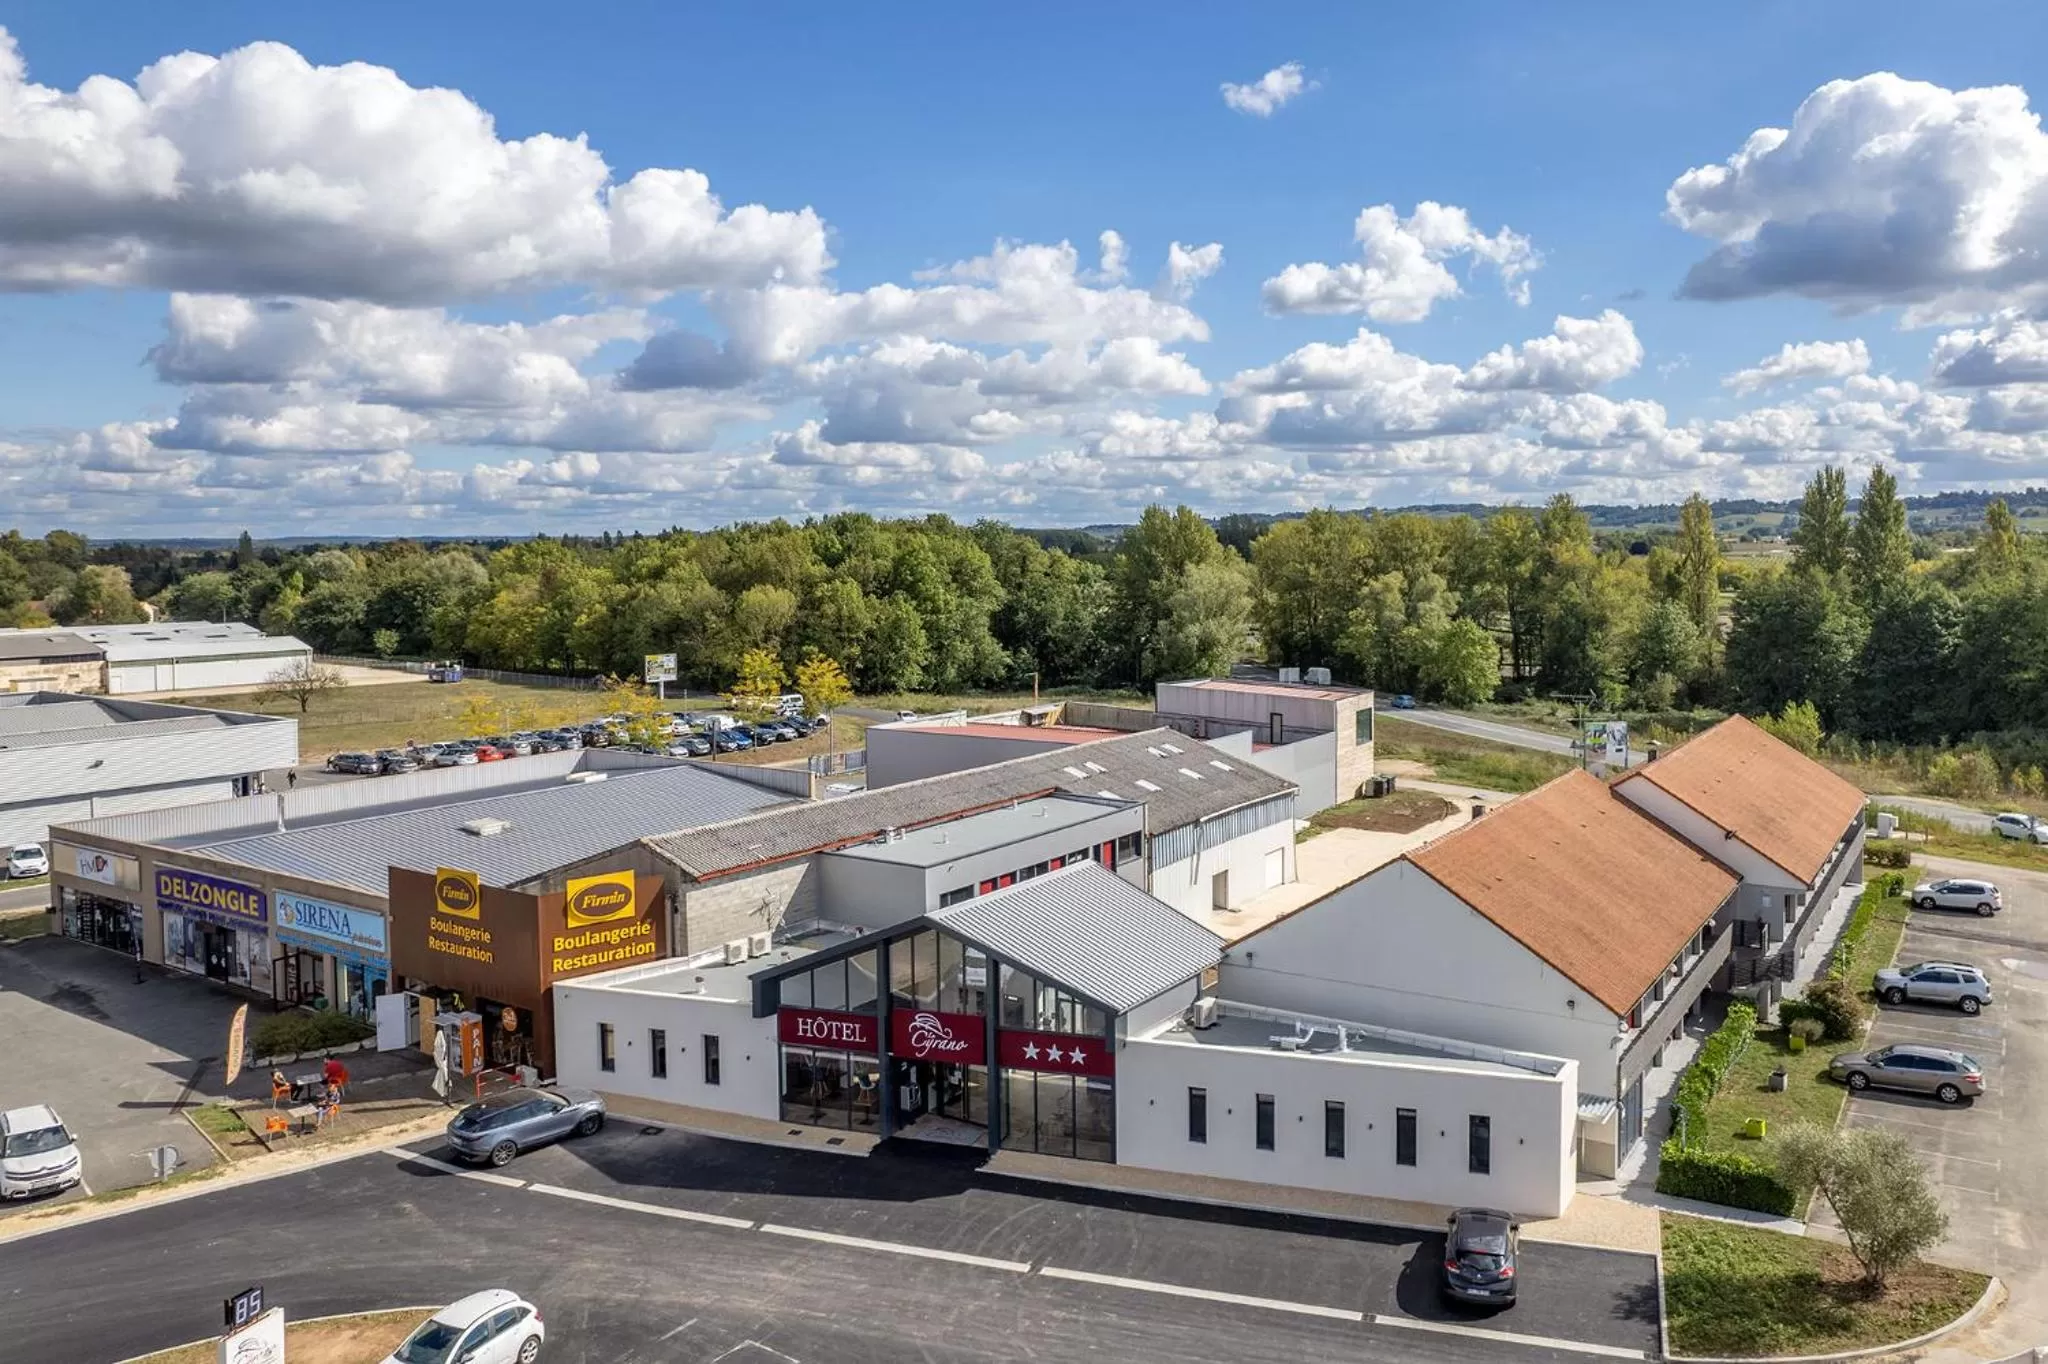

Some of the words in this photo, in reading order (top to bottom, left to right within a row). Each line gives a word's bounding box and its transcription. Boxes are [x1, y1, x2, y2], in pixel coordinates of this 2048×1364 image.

[160, 875, 259, 917] DELZONGLE
[443, 886, 469, 901] Firmin
[582, 891, 626, 909] Firmin
[295, 901, 352, 936] SIRENA
[430, 917, 491, 944] Boulangerie
[428, 936, 494, 963] Restauration
[553, 921, 651, 952] Boulangerie
[552, 941, 656, 973] Restauration
[797, 1016, 867, 1043] HÔTEL
[911, 1030, 969, 1057] Cyrano
[235, 1290, 262, 1324] 85
